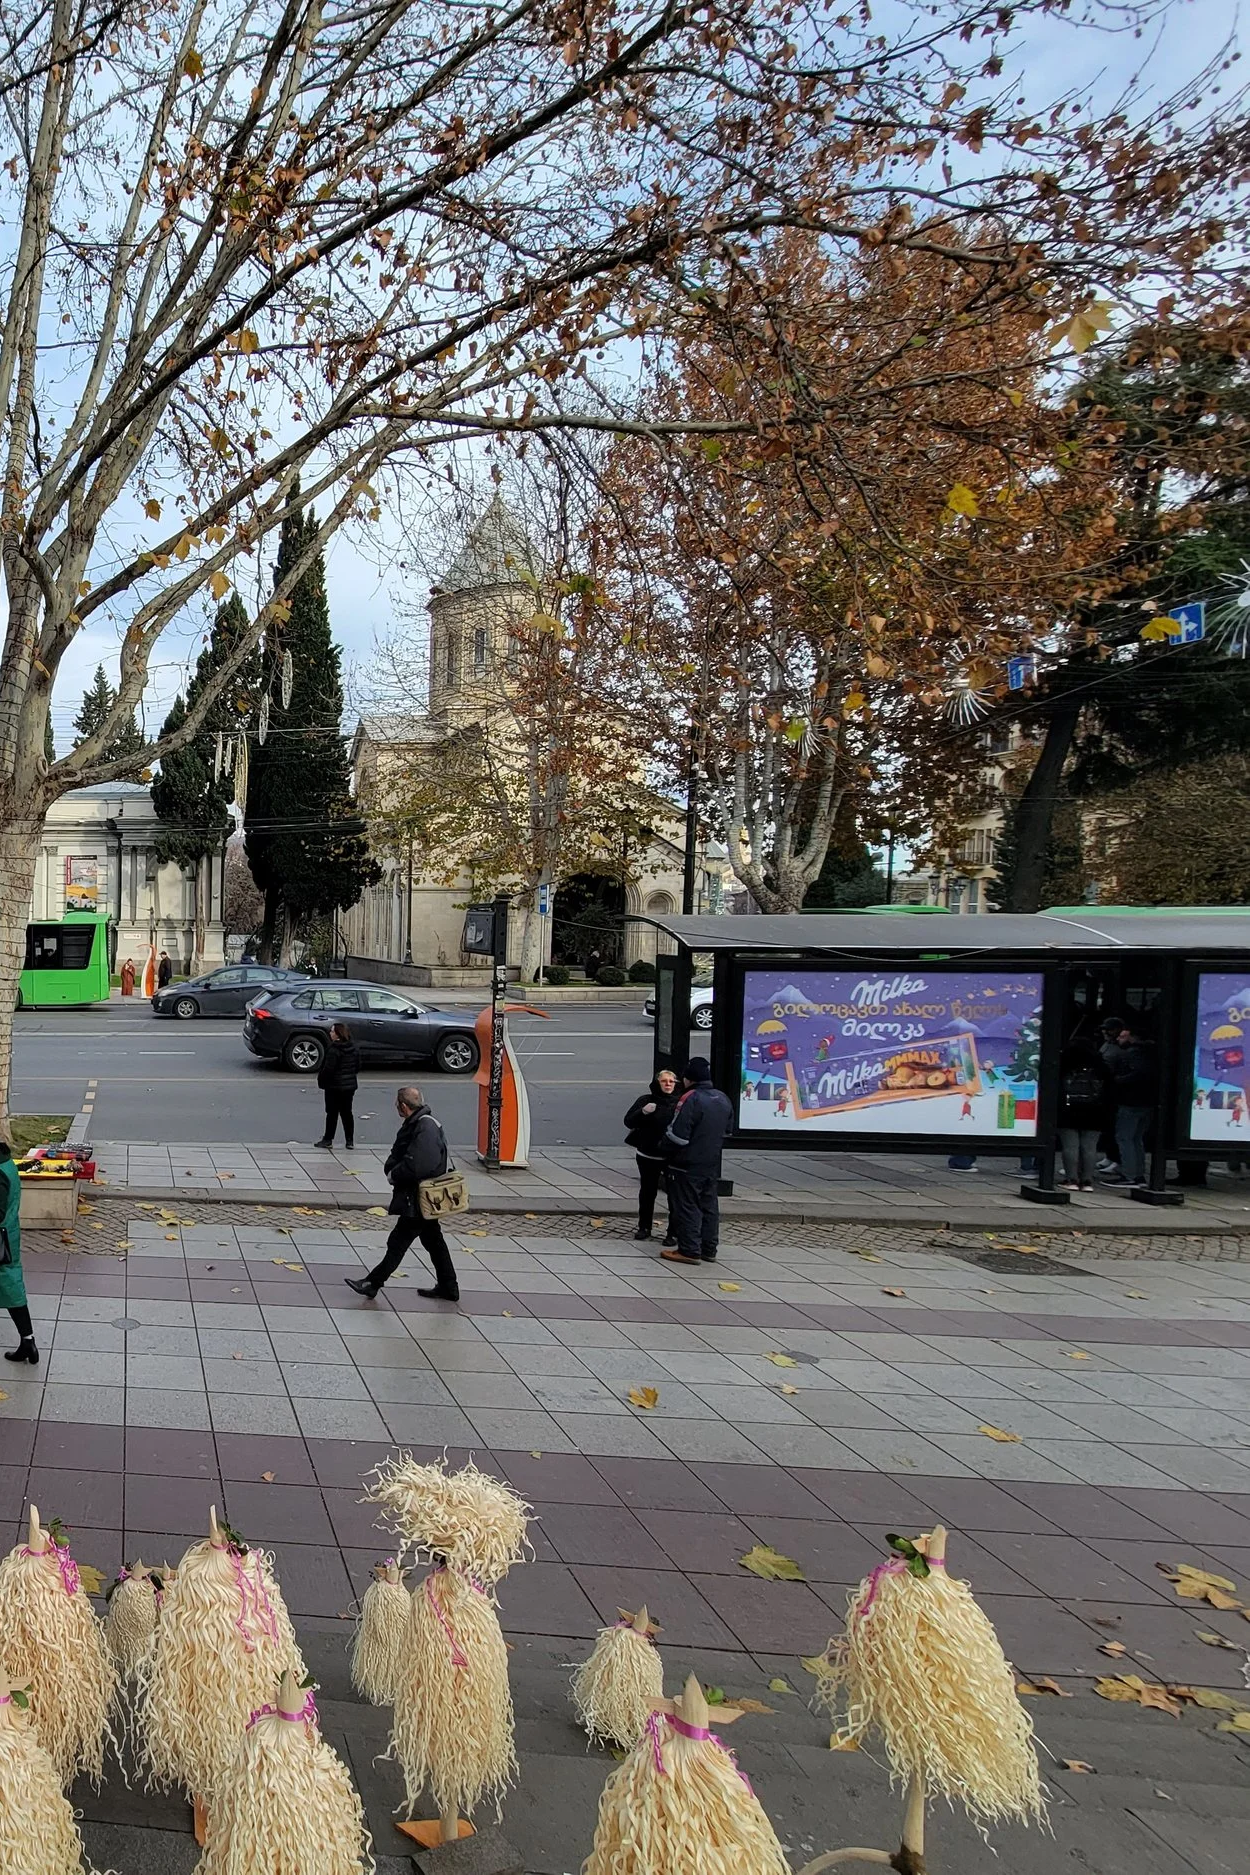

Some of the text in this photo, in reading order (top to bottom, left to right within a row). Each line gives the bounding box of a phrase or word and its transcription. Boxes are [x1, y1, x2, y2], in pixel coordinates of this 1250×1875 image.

[851, 974, 928, 1008] Milka
[893, 1001, 947, 1019] ახალ
[841, 1018, 926, 1041] მილკა
[818, 1050, 941, 1098] Milka MMMAX
